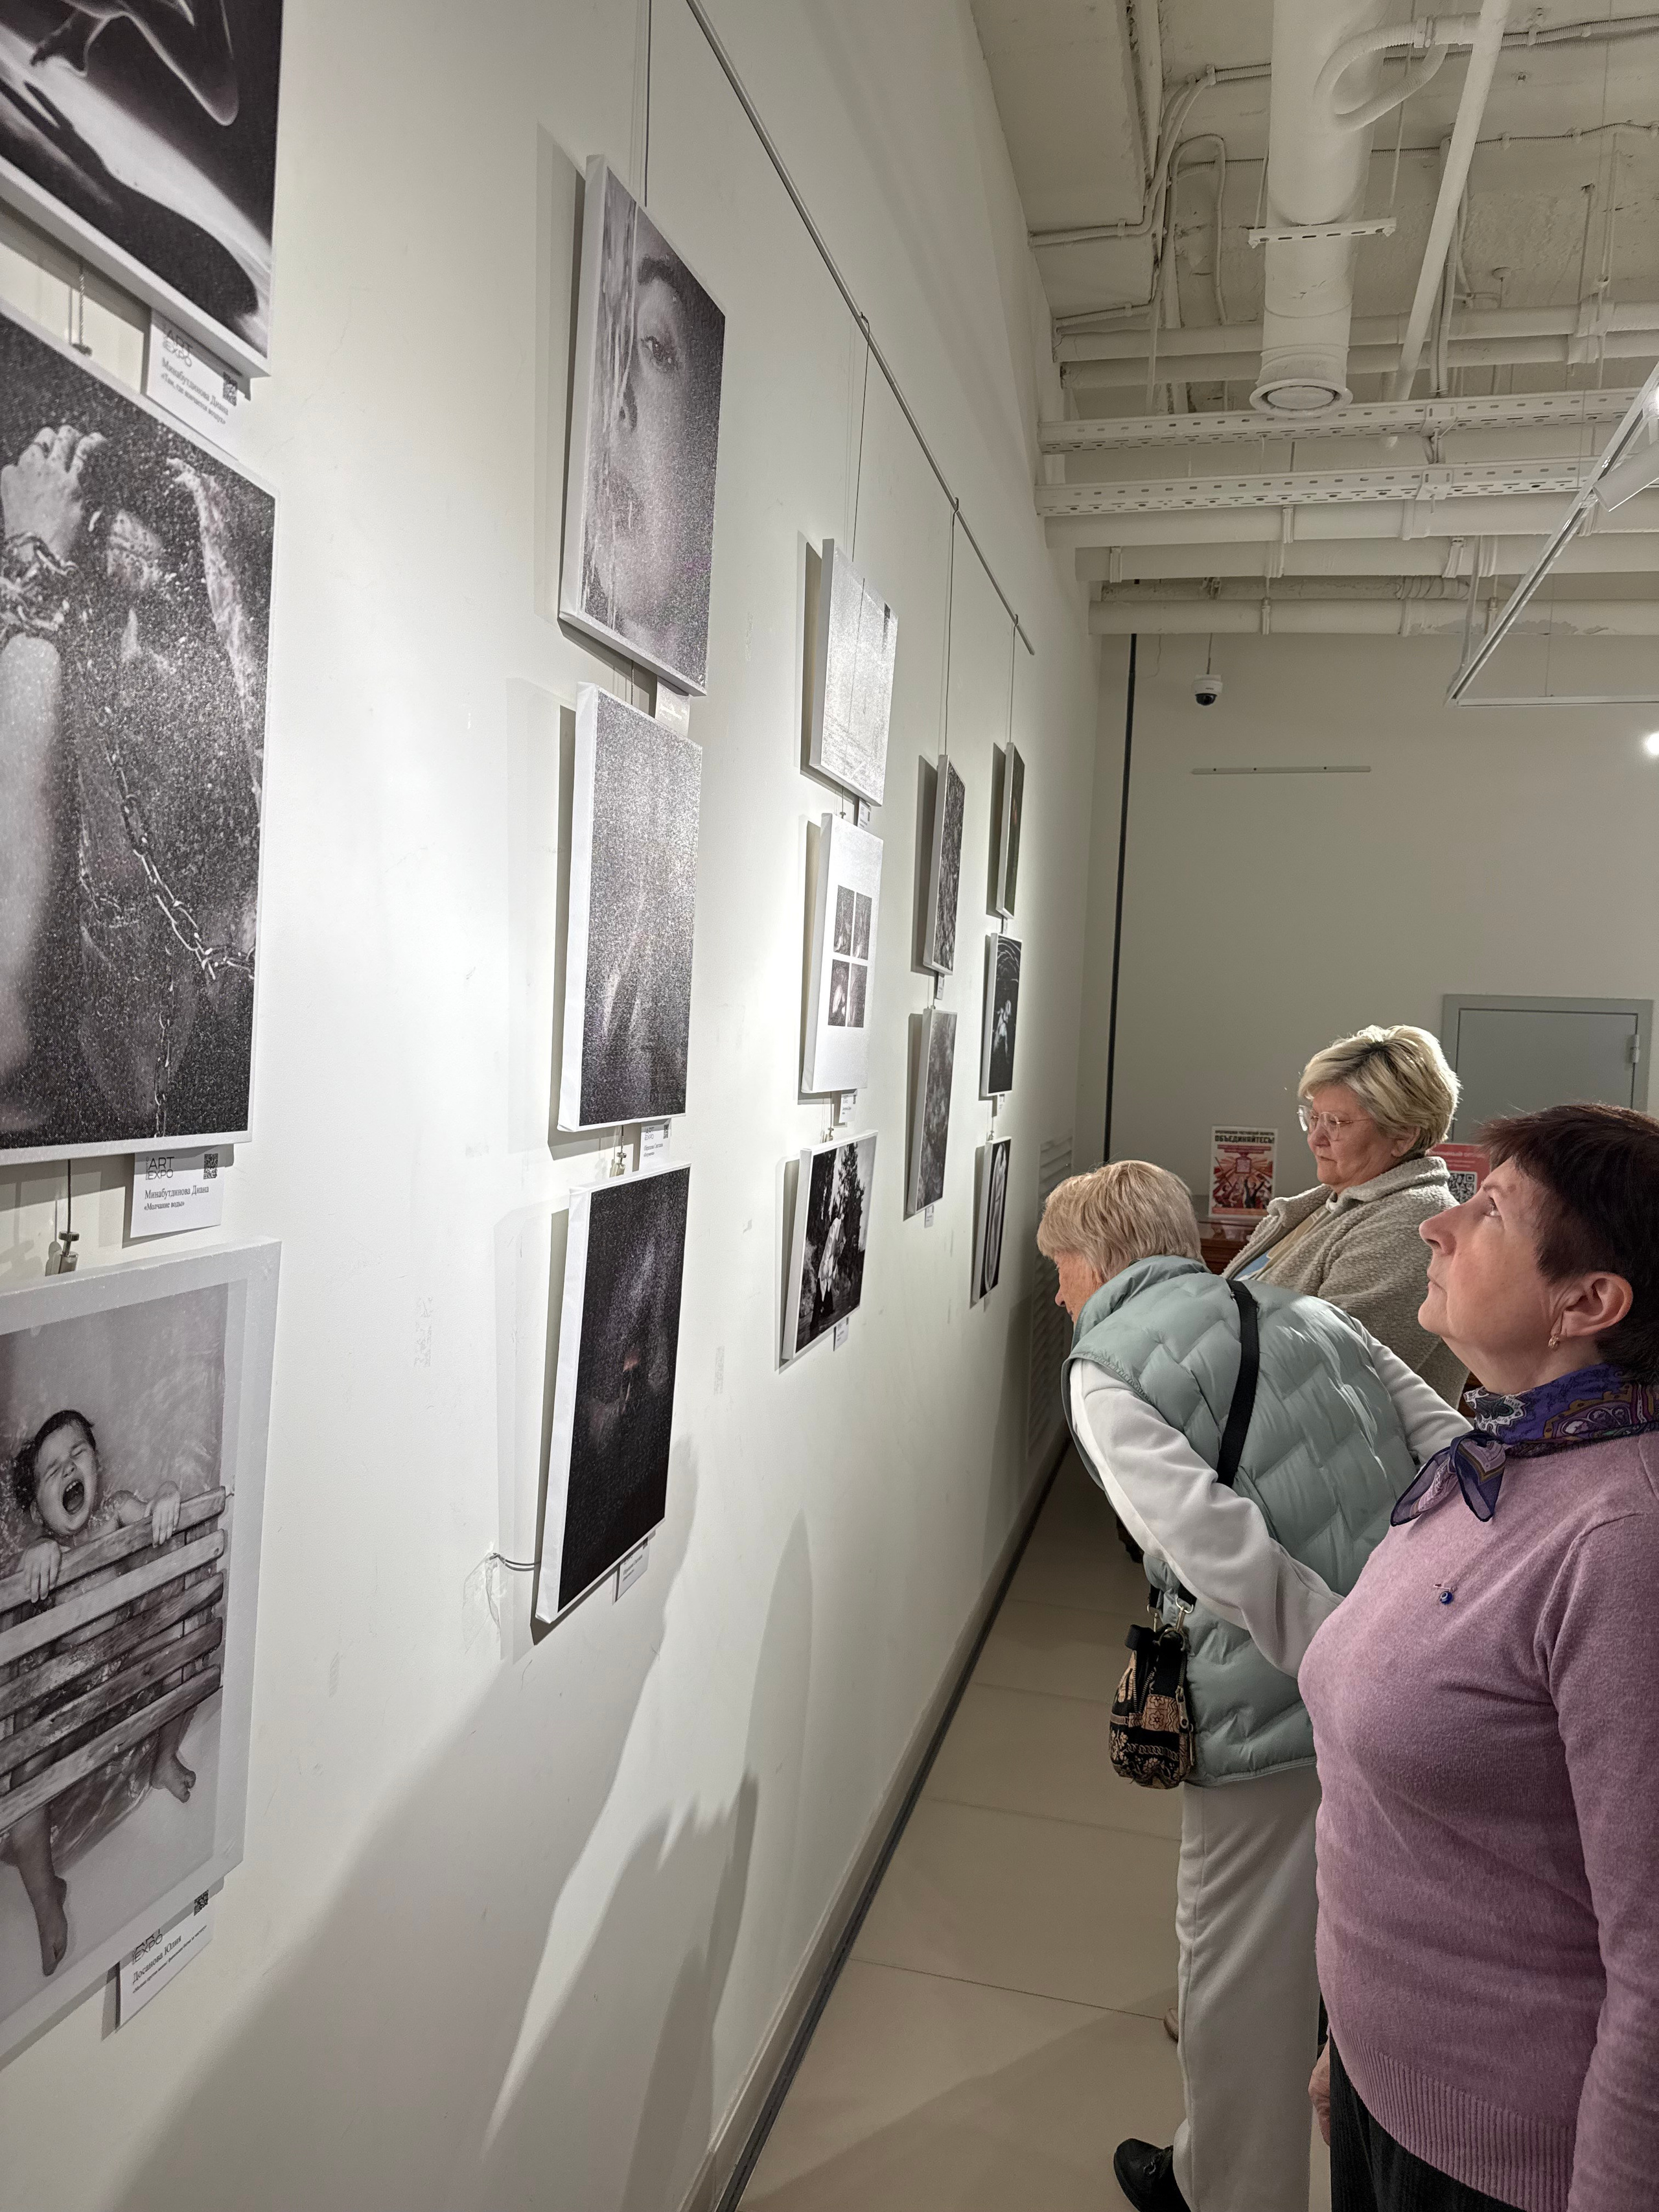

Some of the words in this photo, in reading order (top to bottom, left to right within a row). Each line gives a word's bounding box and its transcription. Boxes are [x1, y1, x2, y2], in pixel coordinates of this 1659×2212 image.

[149, 1156, 174, 1169] ART
[148, 1169, 173, 1180] EXPO
[145, 1189, 191, 1200] Минабутдинова
[191, 1185, 209, 1196] Диана
[134, 1934, 163, 1962] EXPO
[164, 1935, 182, 1955] Юлия
